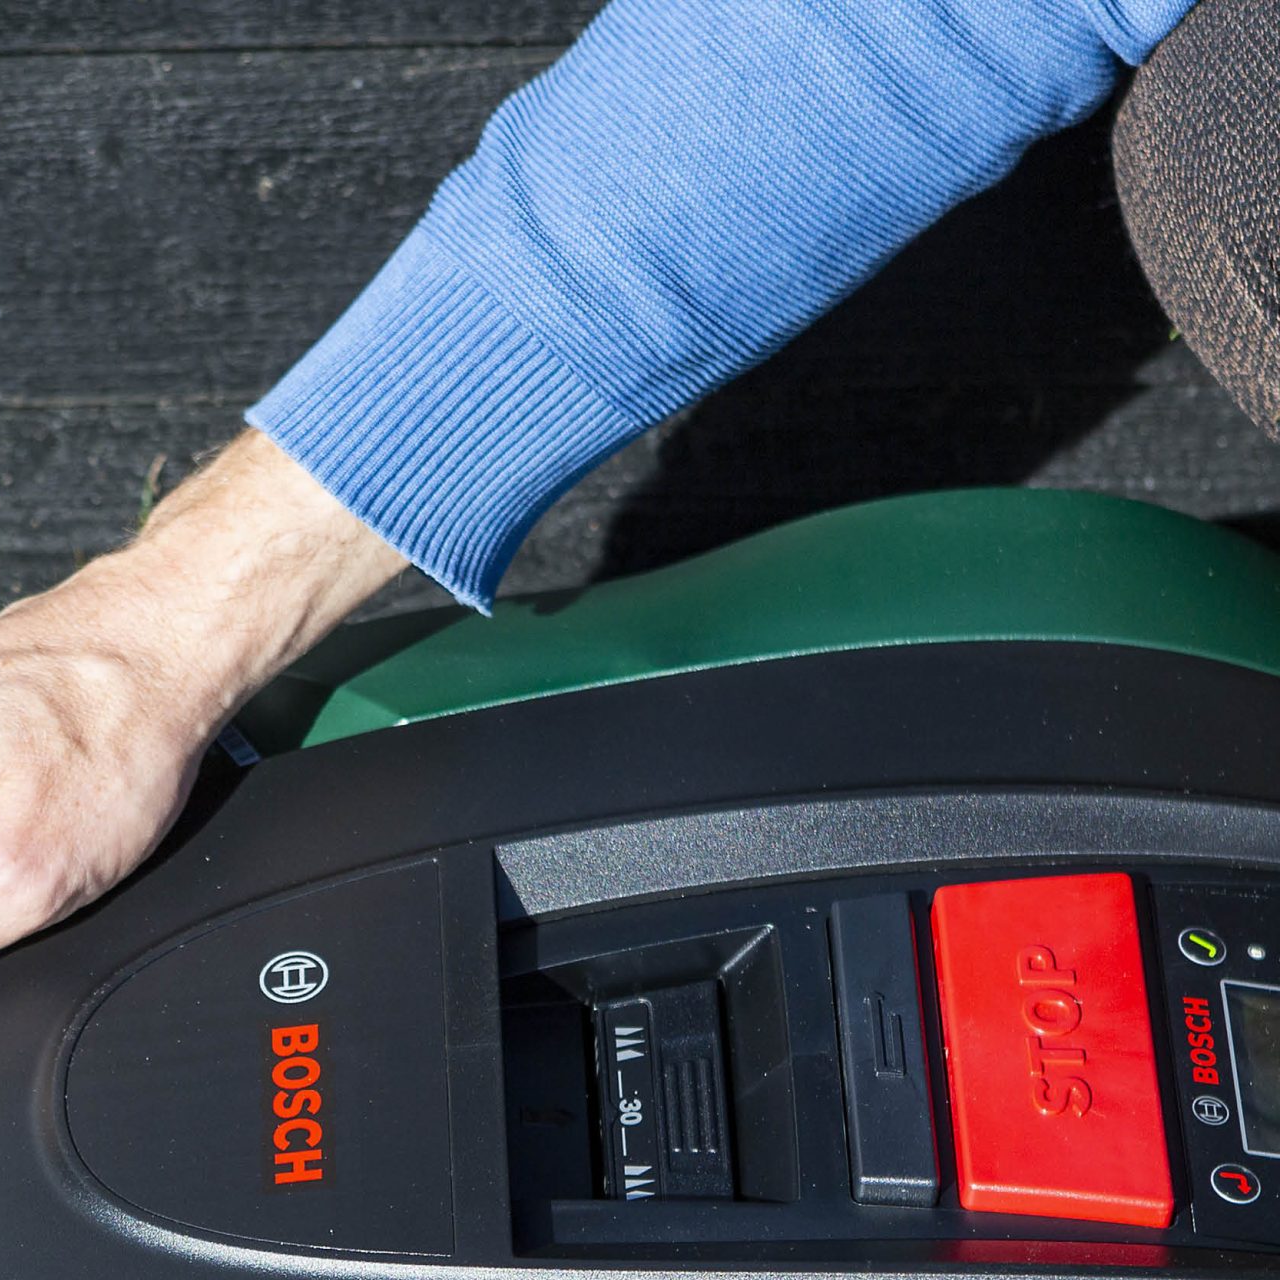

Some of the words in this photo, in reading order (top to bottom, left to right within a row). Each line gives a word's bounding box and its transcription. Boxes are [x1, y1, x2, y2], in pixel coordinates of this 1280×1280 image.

[1016, 944, 1093, 1119] STOP
[1183, 997, 1219, 1085] BOSCH
[271, 1023, 323, 1185] BOSCH
[619, 1098, 643, 1126] 30
